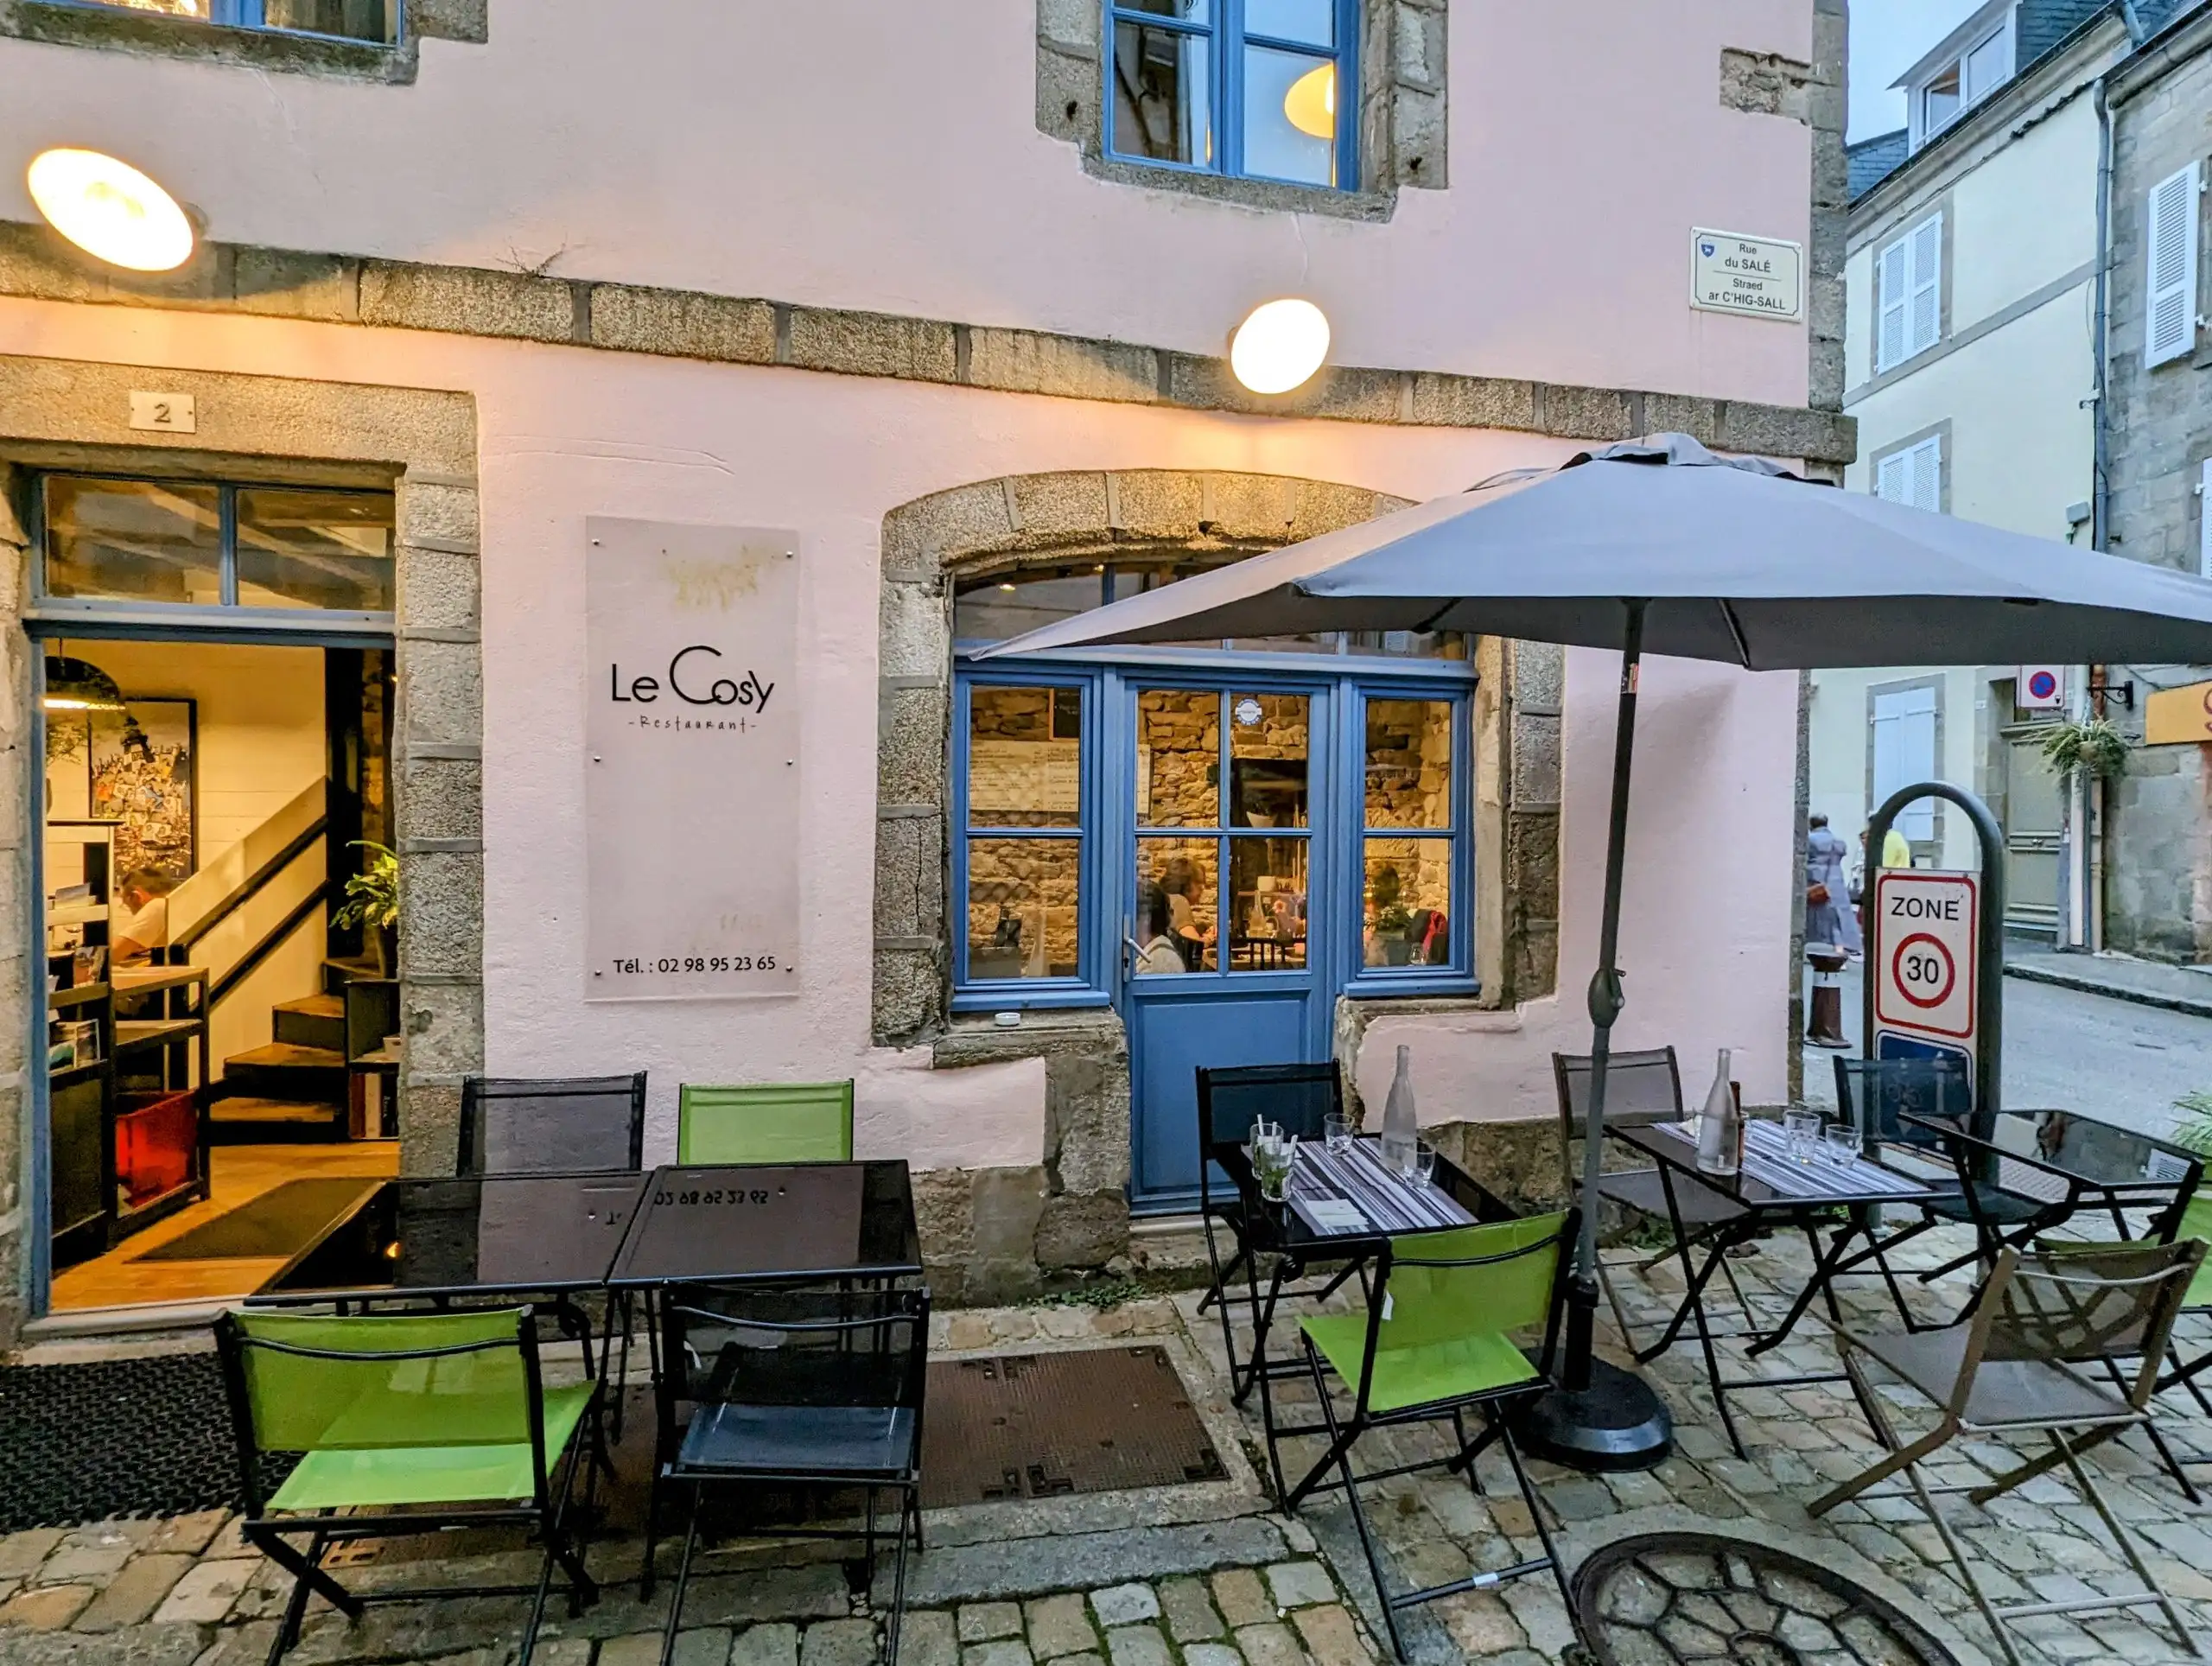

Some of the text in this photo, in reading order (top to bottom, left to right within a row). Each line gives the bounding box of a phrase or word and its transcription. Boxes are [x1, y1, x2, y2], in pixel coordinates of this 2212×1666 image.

[1739, 243, 1757, 255] Rue
[1725, 257, 1771, 273] du SALÉ
[1732, 277, 1763, 291] Straed
[1708, 291, 1786, 310] ar C'HIG-SALL
[154, 403, 171, 423] 2
[612, 645, 775, 714] Le Cosy
[1891, 897, 1959, 920] ZONE
[613, 957, 644, 974] Tél.
[658, 958, 679, 972] 02
[683, 957, 705, 972] 98
[709, 957, 729, 971] 95
[734, 957, 752, 970] 23
[757, 956, 776, 970] 65
[1906, 956, 1939, 984] 30
